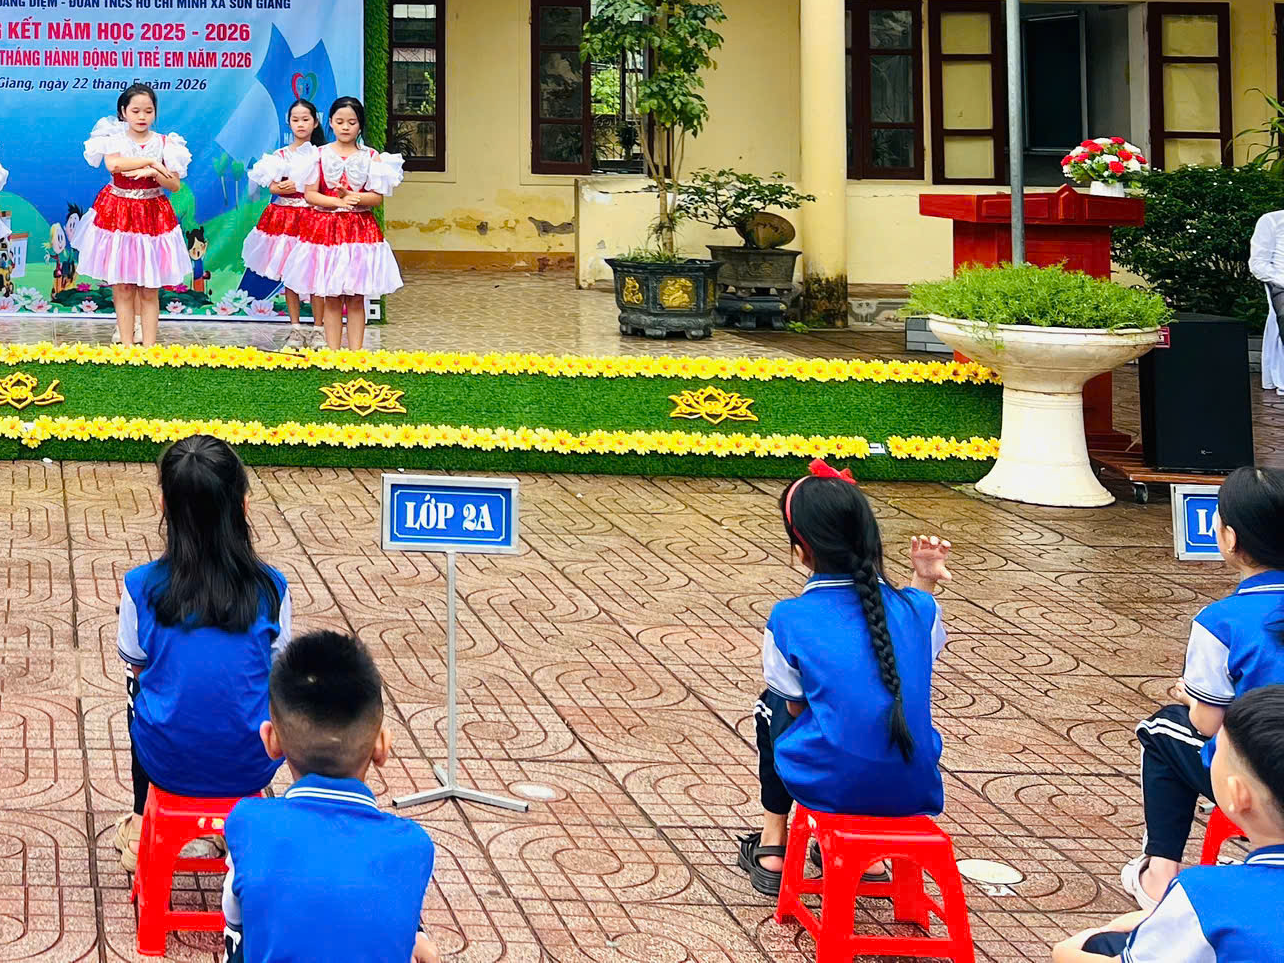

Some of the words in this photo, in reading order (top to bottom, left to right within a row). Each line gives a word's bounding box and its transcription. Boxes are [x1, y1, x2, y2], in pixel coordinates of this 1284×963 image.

[8, 16, 43, 40] KẾT
[47, 18, 92, 41] NĂM
[97, 22, 135, 45] HỌC
[140, 23, 186, 42] 2025
[204, 23, 251, 42] 2026
[0, 47, 40, 67] THÁNG
[44, 47, 80, 67] HÀNH
[83, 48, 118, 71] ĐỘNG
[121, 48, 135, 68] VÌ
[137, 45, 161, 68] TRẺ
[164, 51, 185, 68] EM
[188, 49, 217, 69] NĂM
[221, 51, 253, 69] 2026
[38, 77, 70, 92] ngày
[72, 77, 89, 90] 22
[92, 77, 128, 93] tháng
[175, 78, 208, 91] 2026
[404, 493, 455, 531] LỚP
[462, 503, 495, 532] 2A
